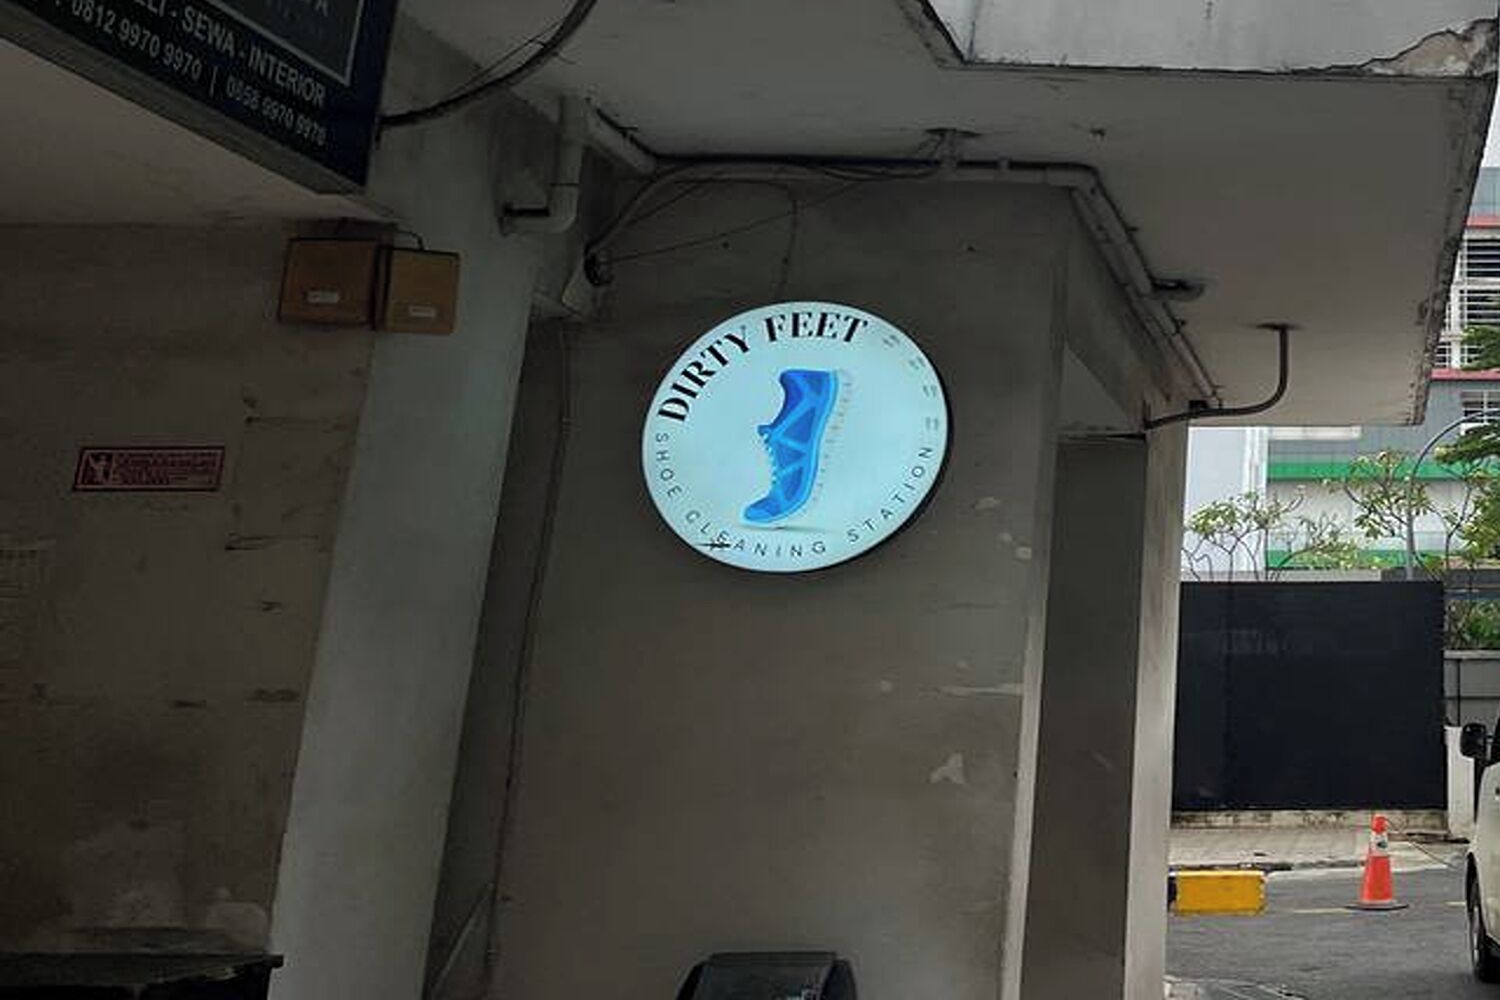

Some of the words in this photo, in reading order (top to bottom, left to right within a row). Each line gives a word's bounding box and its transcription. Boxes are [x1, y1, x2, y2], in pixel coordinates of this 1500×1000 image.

[118, 17, 161, 58] 9970
[162, 43, 202, 80] 9970
[182, 6, 236, 58] SEWA
[248, 46, 326, 108] INTERIOR
[657, 324, 751, 422] DIRTY
[763, 311, 868, 343] FEET
[655, 432, 682, 498] SHOE
[684, 508, 827, 558] CLEANING
[847, 447, 934, 544] STATION
